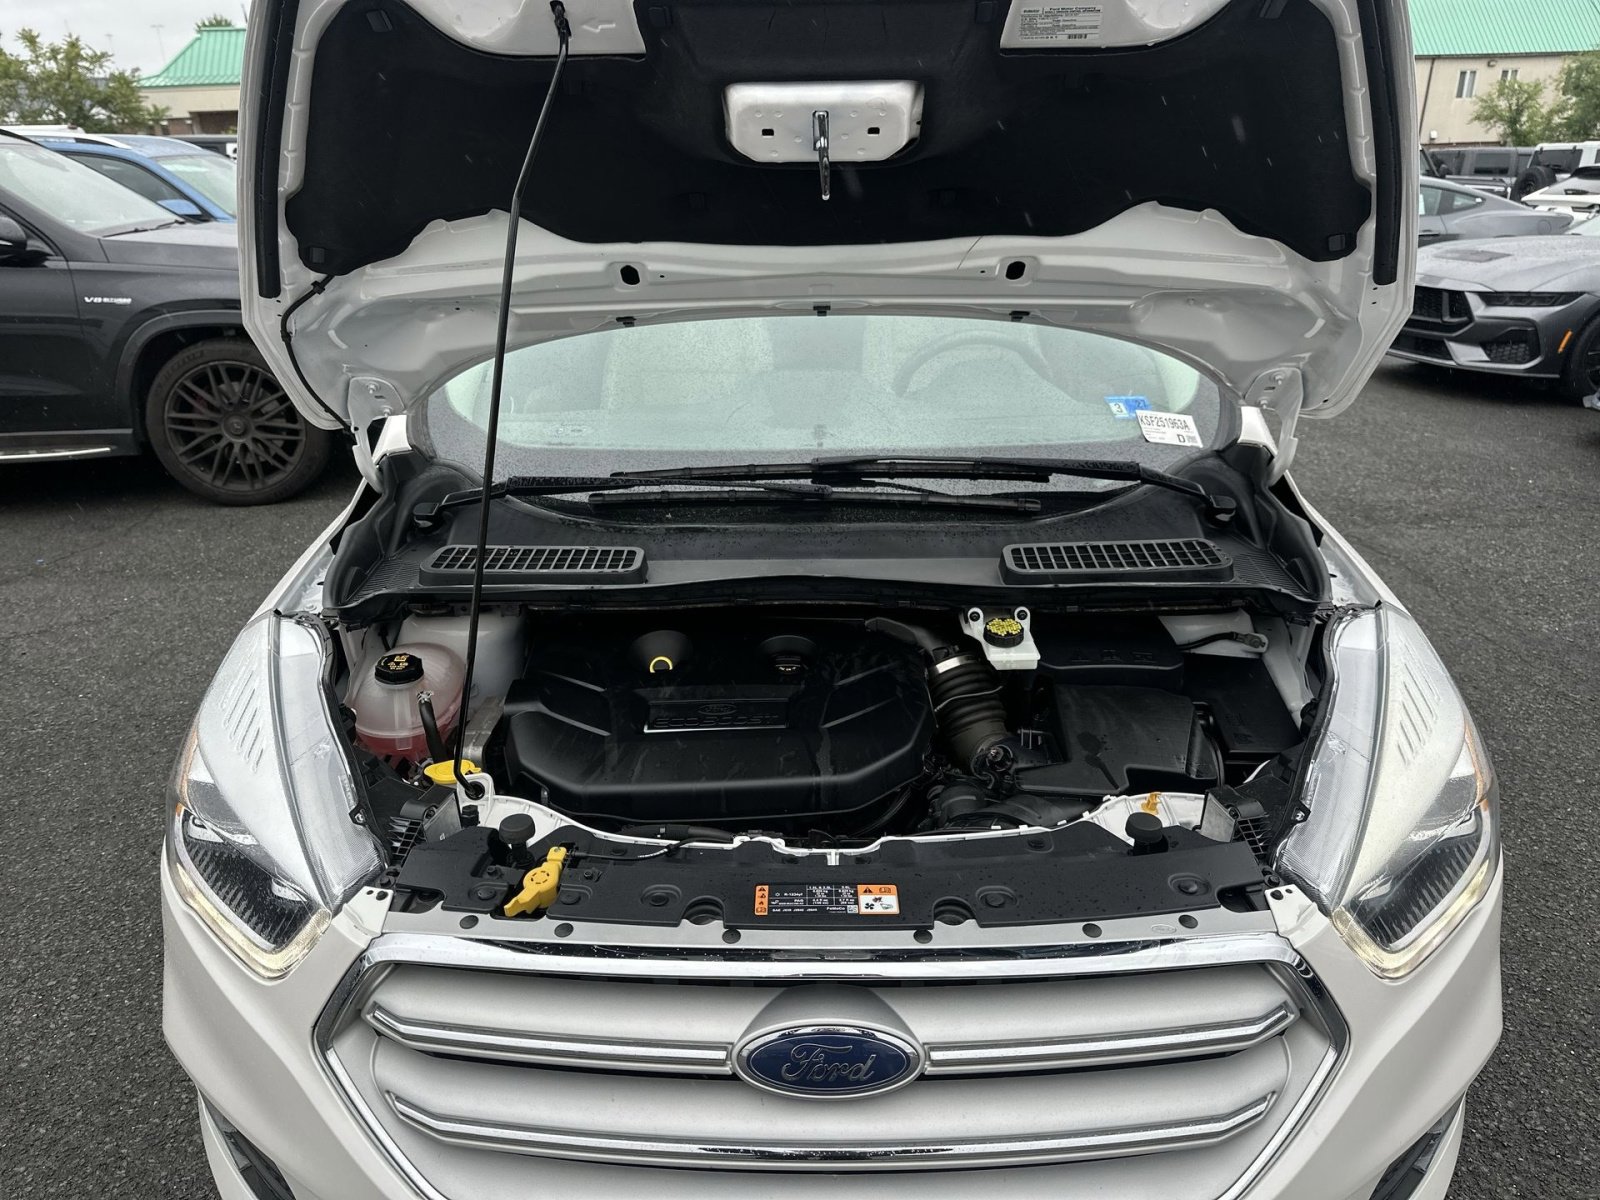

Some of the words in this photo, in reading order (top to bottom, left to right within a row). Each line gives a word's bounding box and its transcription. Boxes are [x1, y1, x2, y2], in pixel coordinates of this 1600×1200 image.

[1114, 403, 1123, 413] 3
[1140, 415, 1191, 432] KSF251963A
[1177, 434, 1186, 443] D
[781, 1043, 877, 1081] Ford
